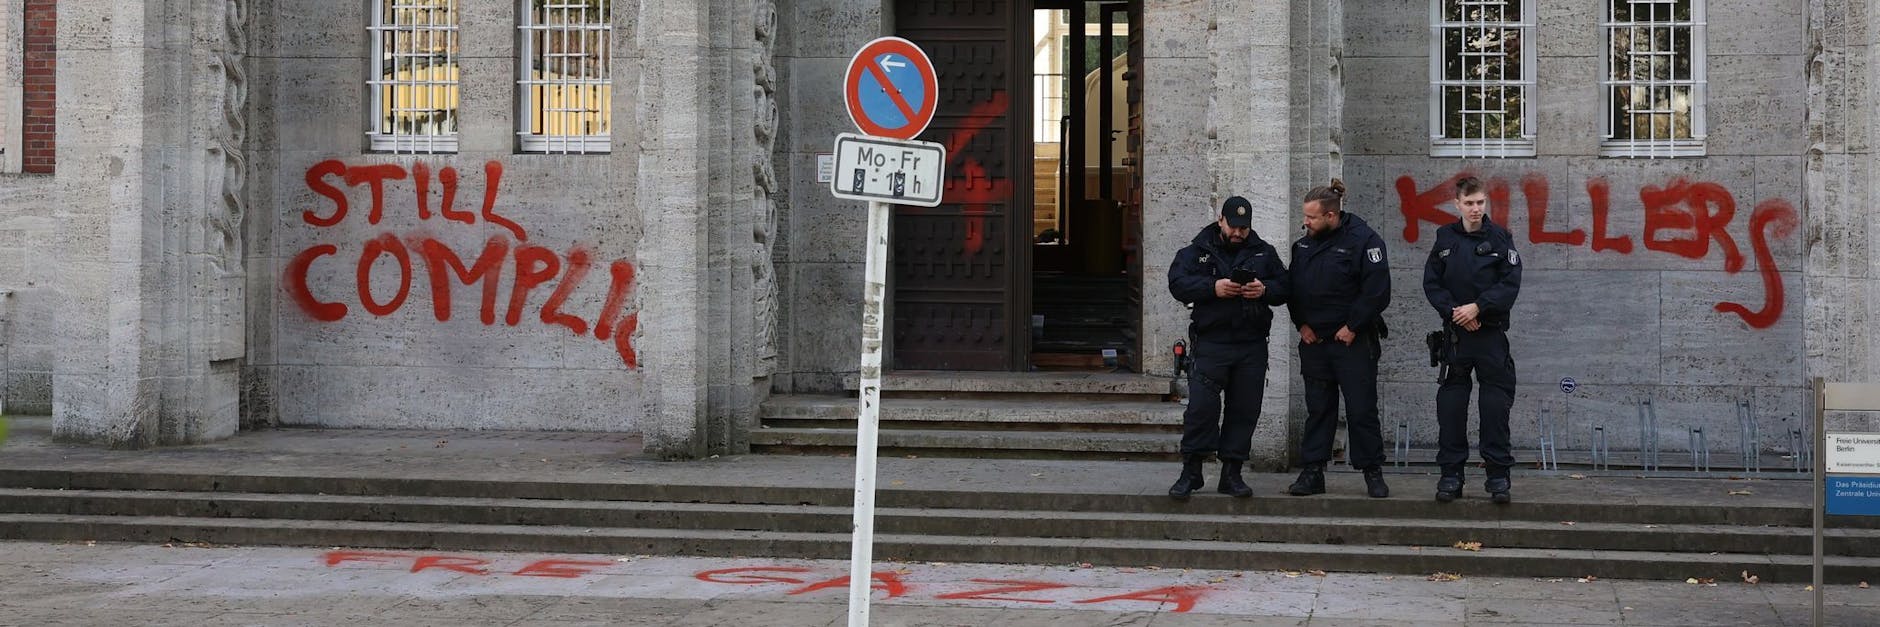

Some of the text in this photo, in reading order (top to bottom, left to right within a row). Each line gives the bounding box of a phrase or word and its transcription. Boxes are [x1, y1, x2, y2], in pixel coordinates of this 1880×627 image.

[303, 160, 528, 243] STILL
[913, 174, 921, 194] h
[1397, 175, 1796, 330] KILLERS
[696, 565, 1212, 614] GAZA
